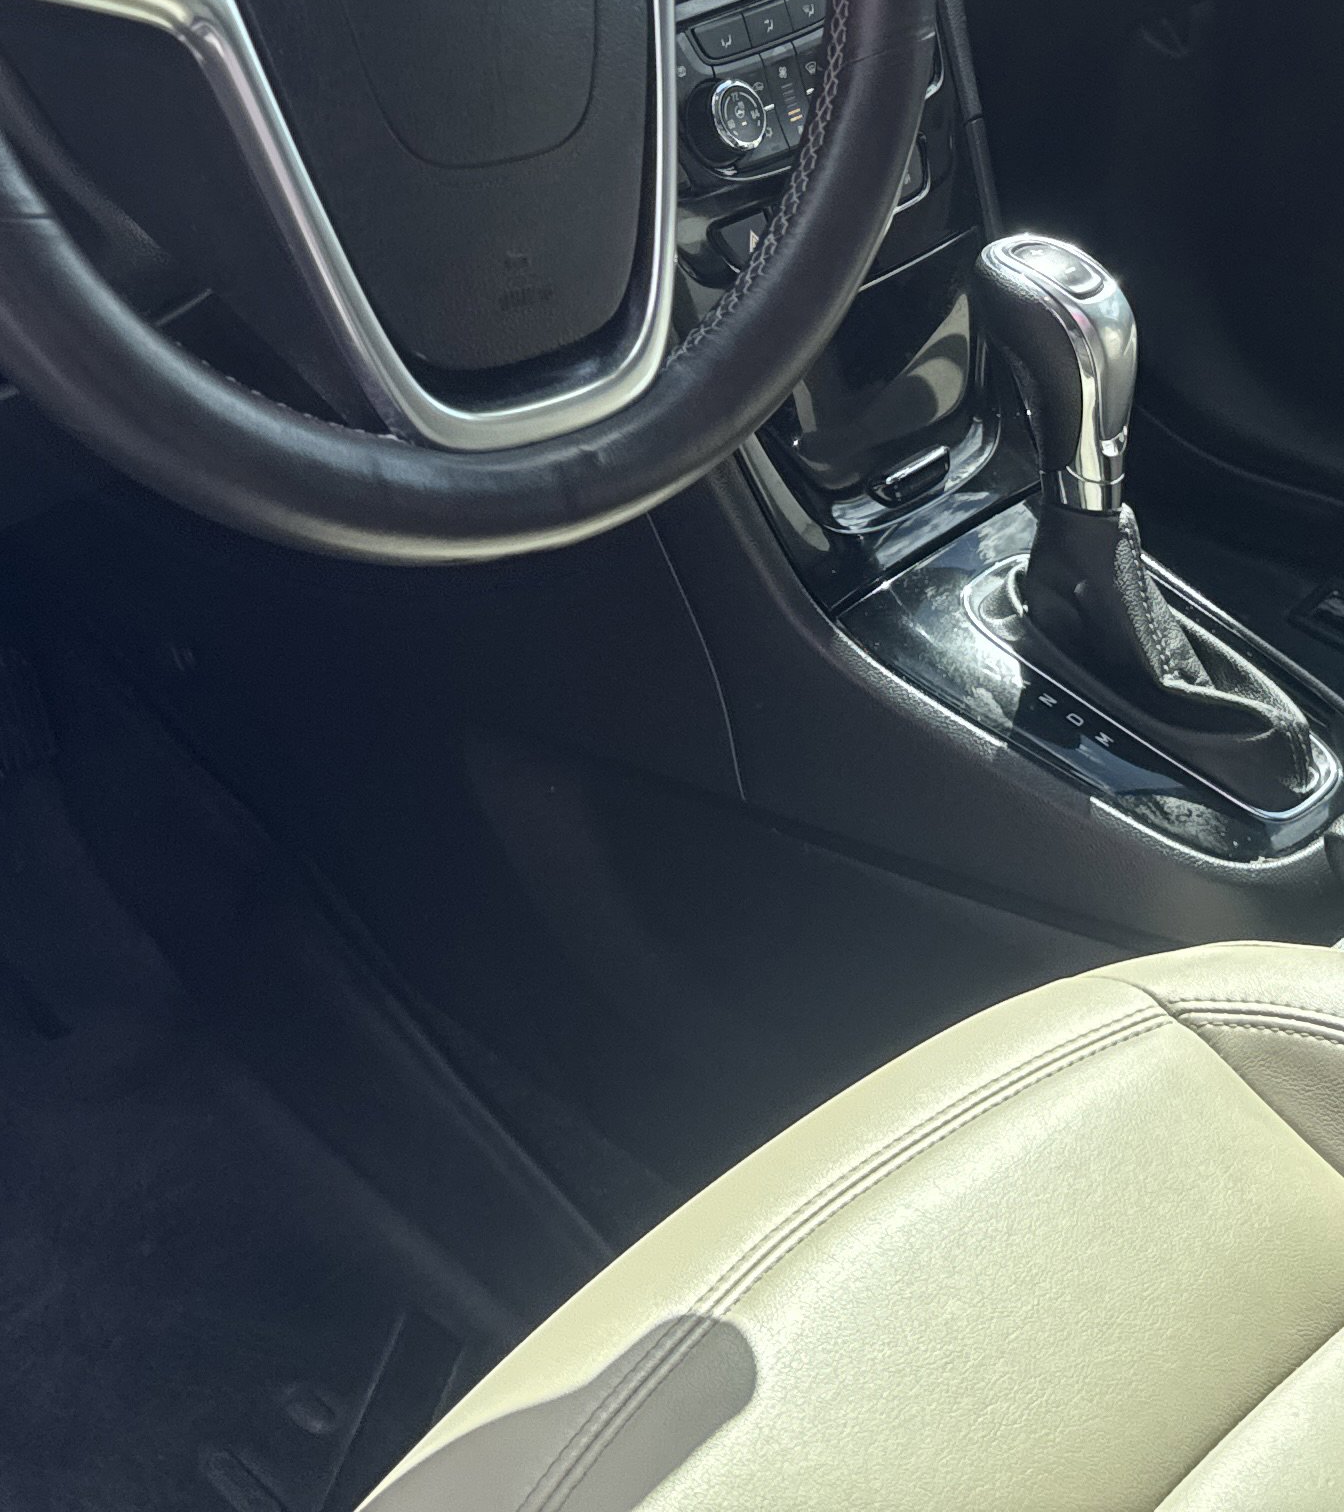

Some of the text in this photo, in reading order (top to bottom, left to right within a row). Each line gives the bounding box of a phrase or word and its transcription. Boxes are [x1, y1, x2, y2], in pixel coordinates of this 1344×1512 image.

[1038, 693, 1057, 708] N
[1066, 712, 1085, 727] D
[1094, 731, 1115, 748] M
